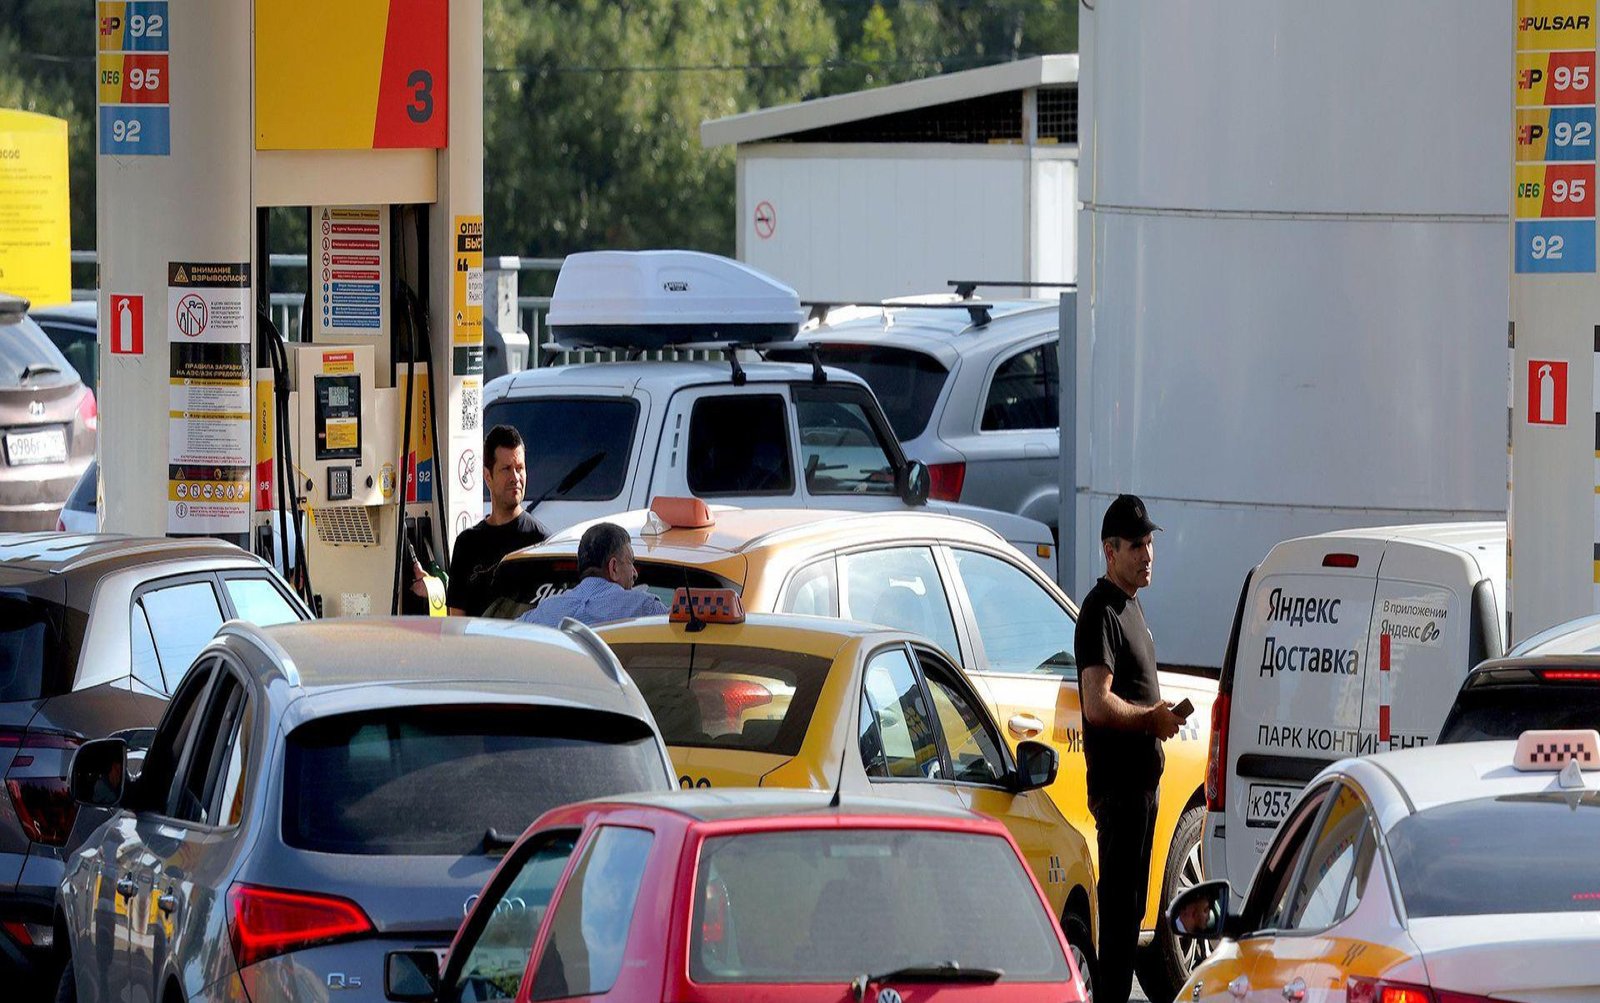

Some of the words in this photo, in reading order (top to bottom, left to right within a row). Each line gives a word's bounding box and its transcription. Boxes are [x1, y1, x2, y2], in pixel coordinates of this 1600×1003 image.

[130, 15, 163, 37] 92
[1523, 15, 1590, 31] PULSAR
[129, 68, 160, 90] 95
[1554, 65, 1591, 91] 95
[406, 70, 433, 124] 3
[113, 119, 141, 142] 92
[1554, 121, 1592, 147] 92
[1551, 179, 1587, 203] 95
[1531, 235, 1564, 260] 92
[191, 266, 231, 274] ВНИМАНИЕ
[259, 481, 270, 491] 95
[418, 471, 431, 483] 92
[1267, 588, 1341, 627] Яндекс
[1383, 600, 1390, 613] В
[1390, 603, 1449, 619] приложении
[1381, 618, 1421, 639] Яндекс
[1421, 621, 1440, 643] Go
[1259, 636, 1360, 678] Доставка
[1257, 725, 1302, 748] ПАРК
[1252, 790, 1294, 818] К953
[327, 972, 361, 988] Q5
